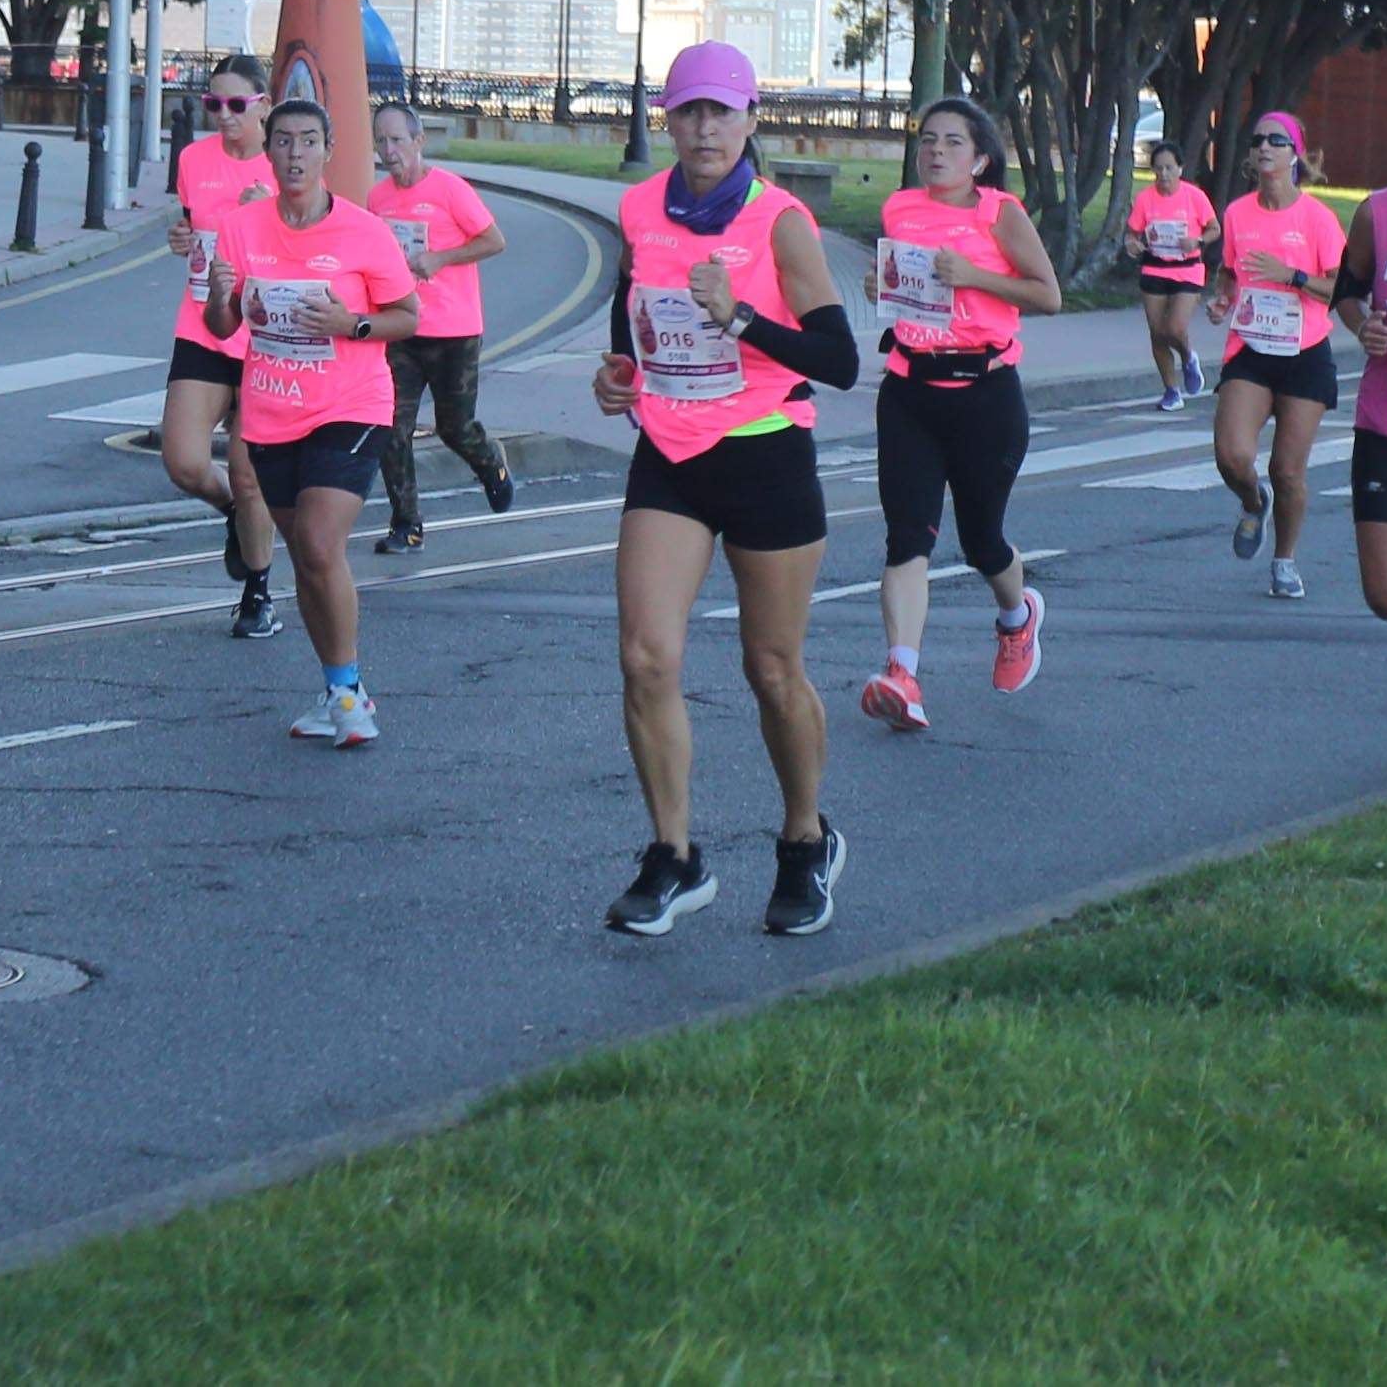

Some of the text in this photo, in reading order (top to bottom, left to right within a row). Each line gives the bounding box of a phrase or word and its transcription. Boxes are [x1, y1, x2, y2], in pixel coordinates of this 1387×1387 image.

[901, 274, 925, 290] 016
[1255, 313, 1279, 327] 016
[659, 331, 695, 348] 016
[250, 368, 303, 400] SUMA
